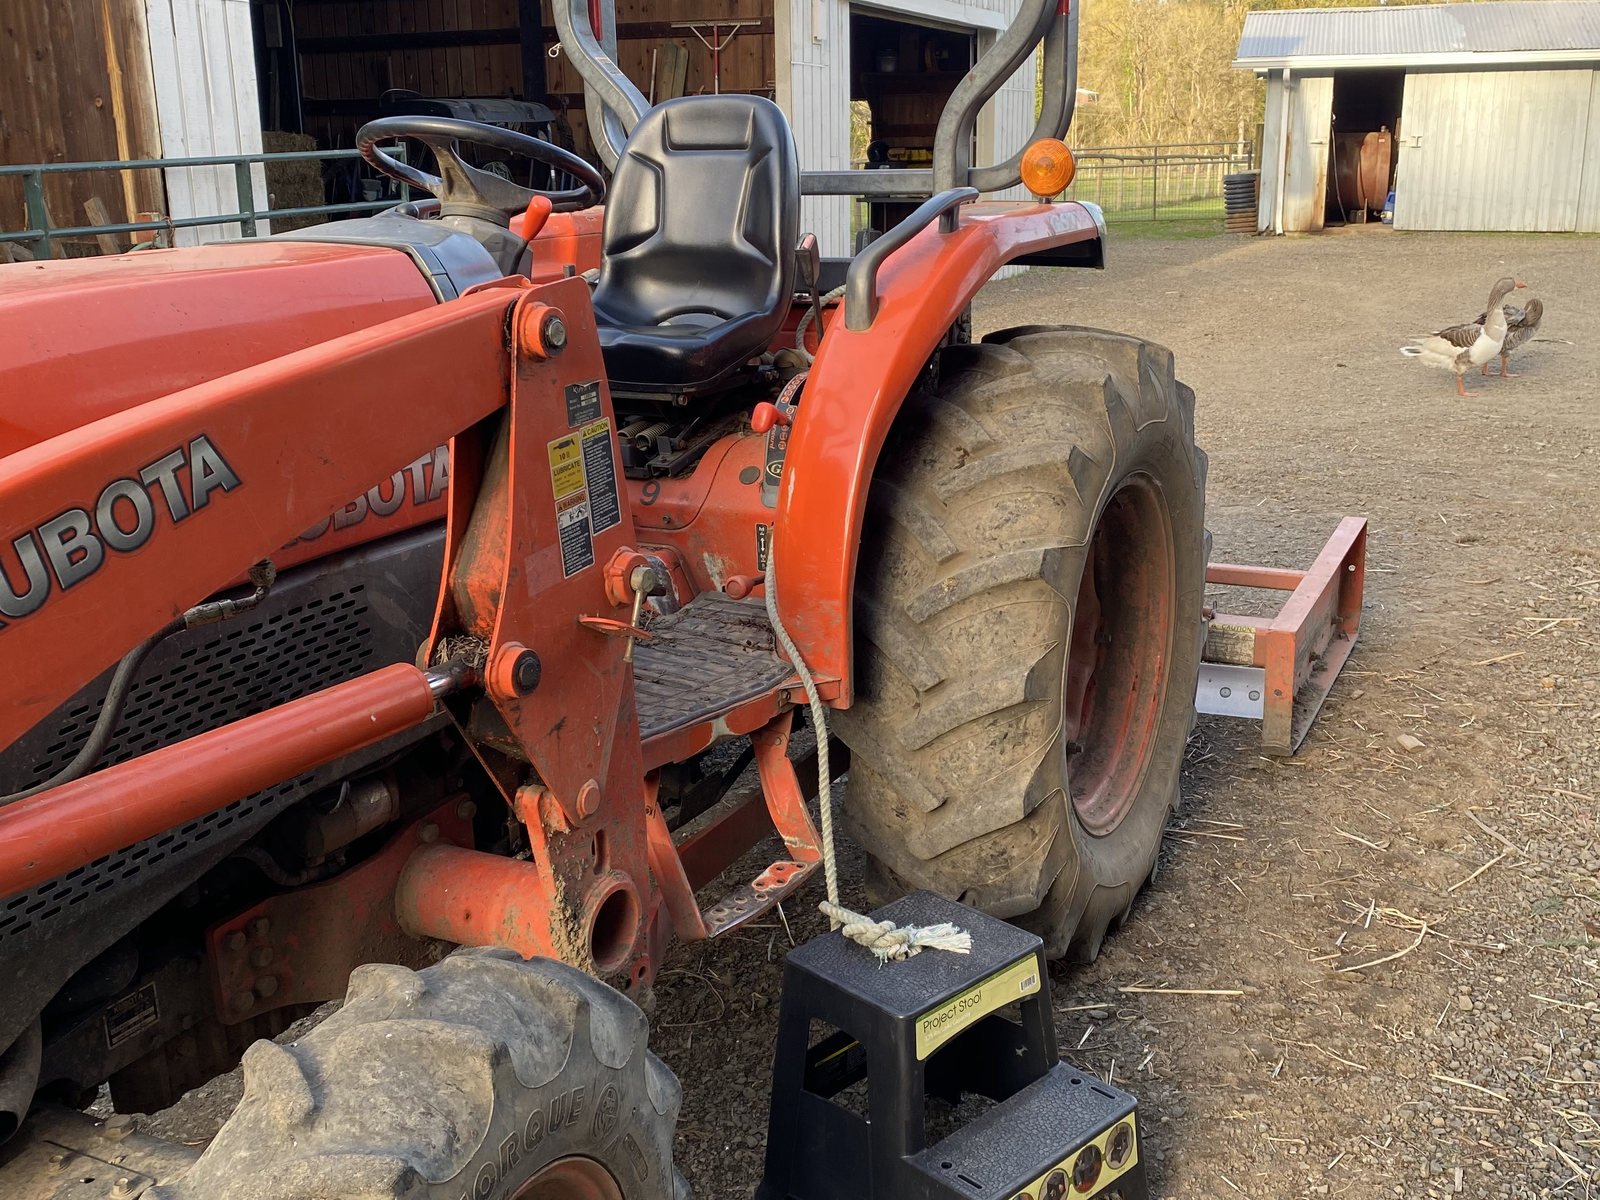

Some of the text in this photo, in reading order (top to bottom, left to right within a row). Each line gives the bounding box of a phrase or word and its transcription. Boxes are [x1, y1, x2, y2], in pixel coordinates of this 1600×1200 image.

[587, 421, 608, 436] CAUTION
[553, 459, 580, 477] LUBRICATE
[563, 493, 585, 508] WARNING
[639, 480, 661, 506] 9
[0, 434, 242, 630] UBOTA
[1221, 624, 1253, 633] CAUTION
[923, 990, 982, 1033] Project Stool
[460, 1086, 586, 1200] ORQUE
